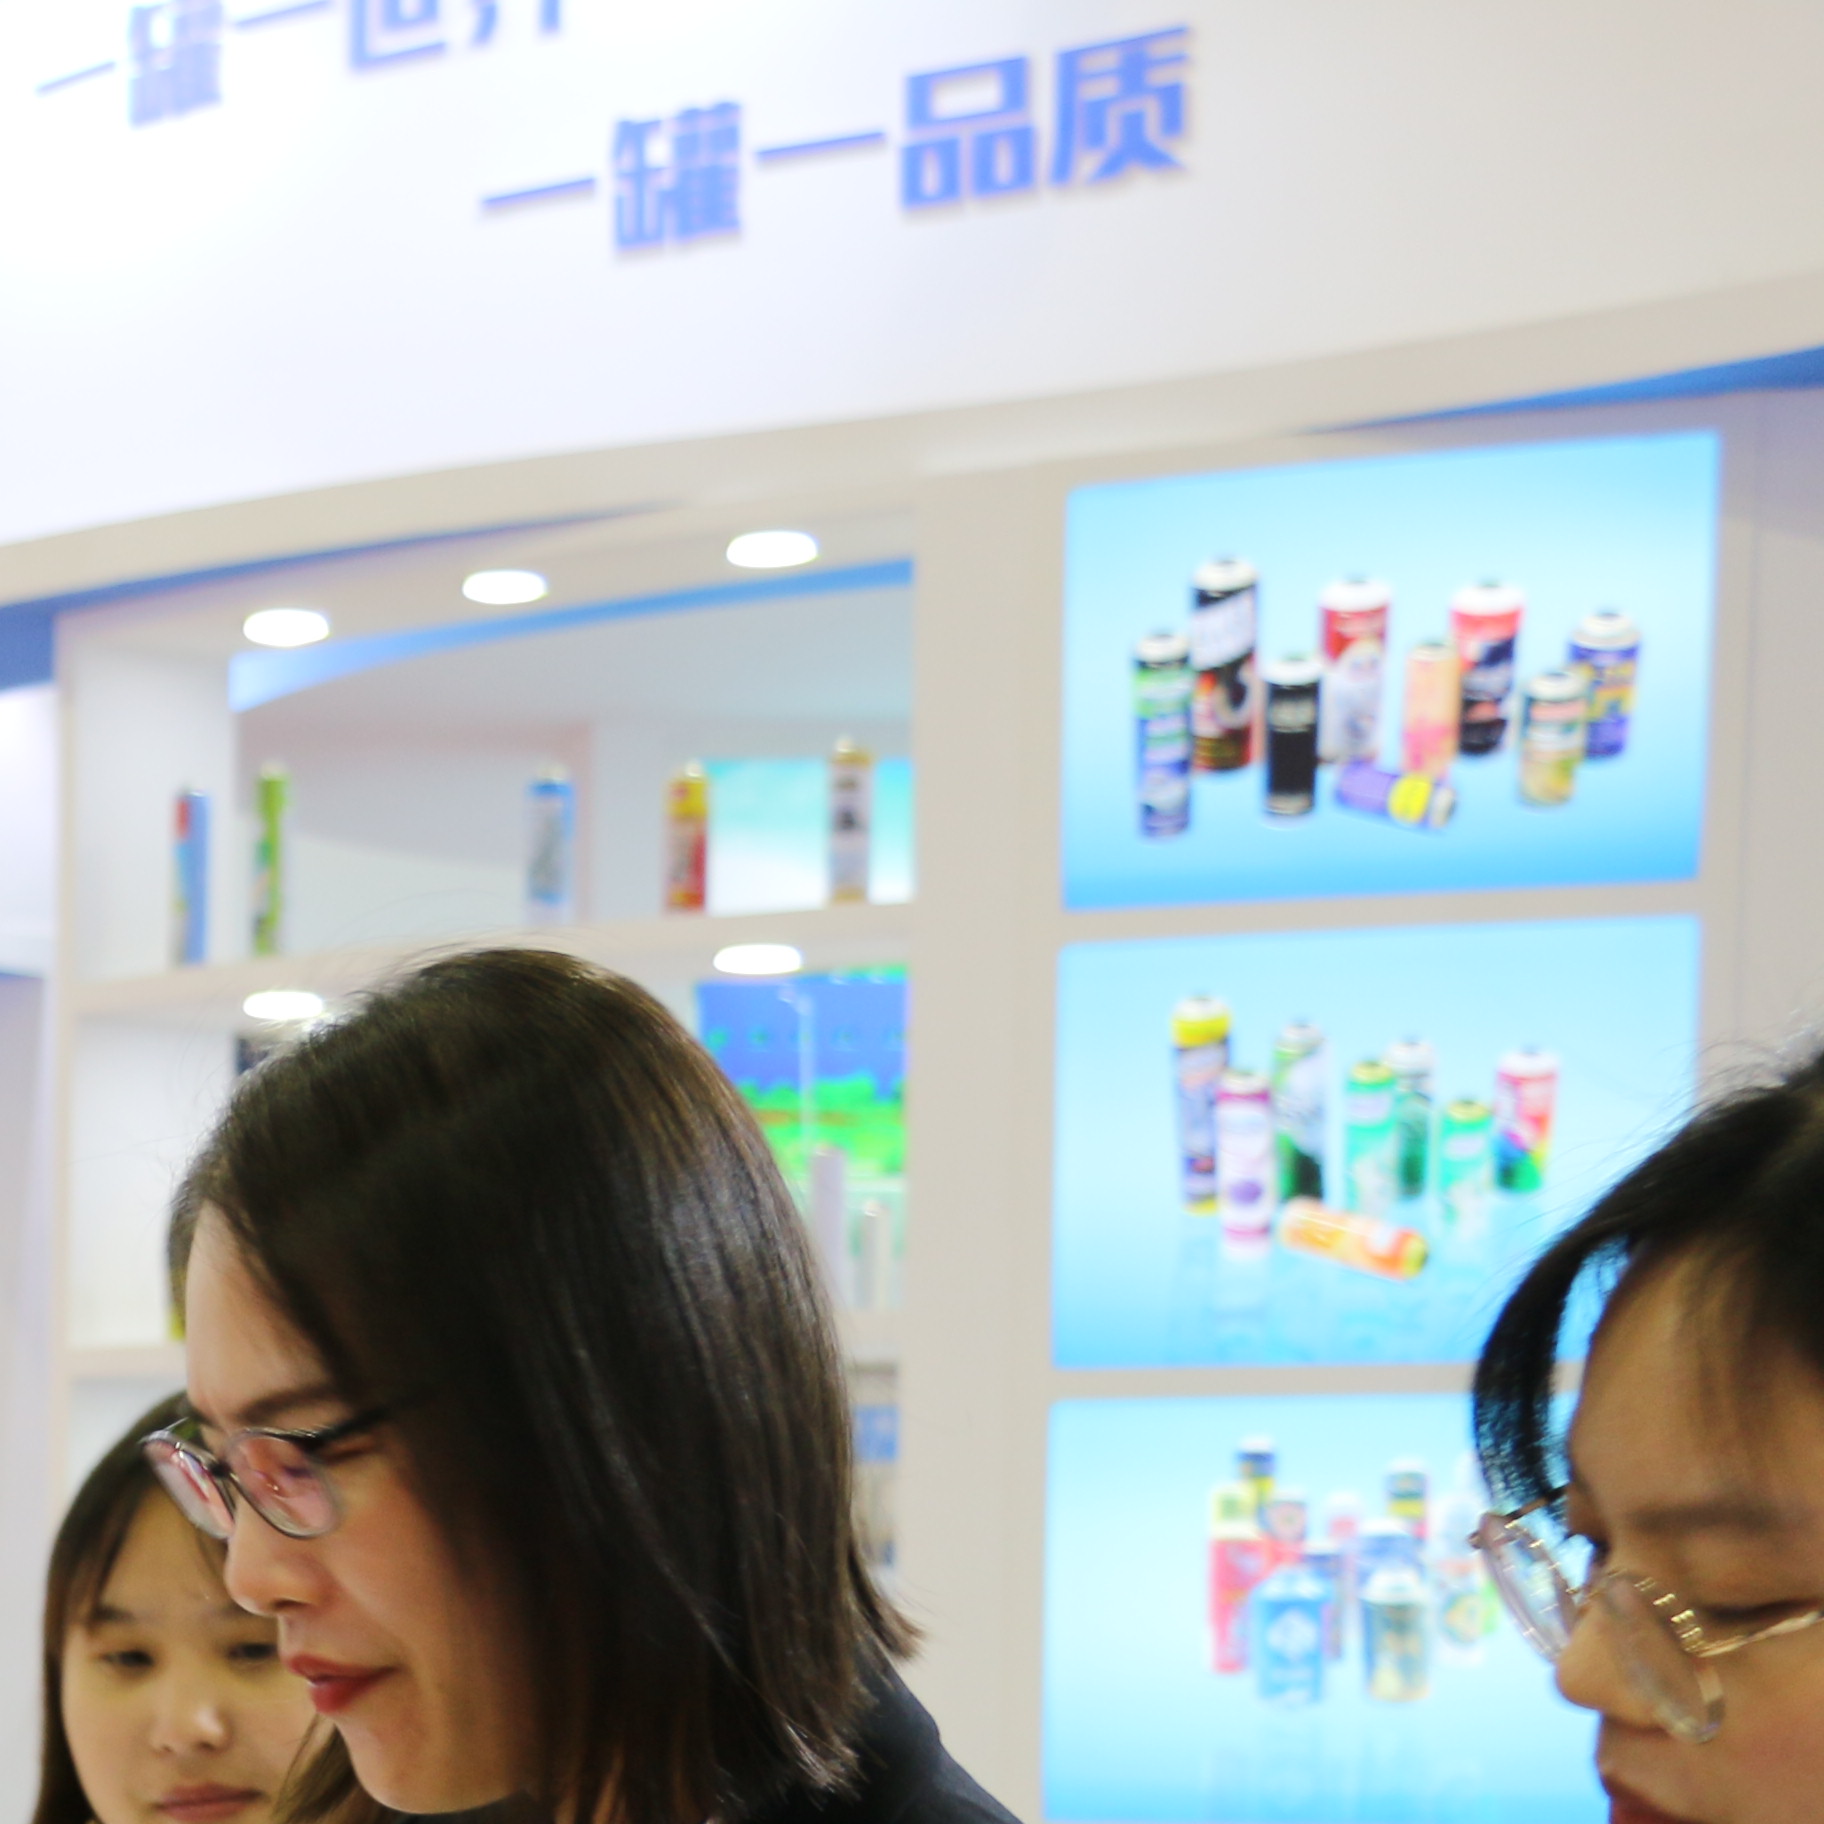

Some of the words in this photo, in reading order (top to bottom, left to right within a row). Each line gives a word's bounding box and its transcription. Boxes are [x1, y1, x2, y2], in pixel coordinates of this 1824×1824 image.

[482, 25, 1190, 252] 一罐一品质
